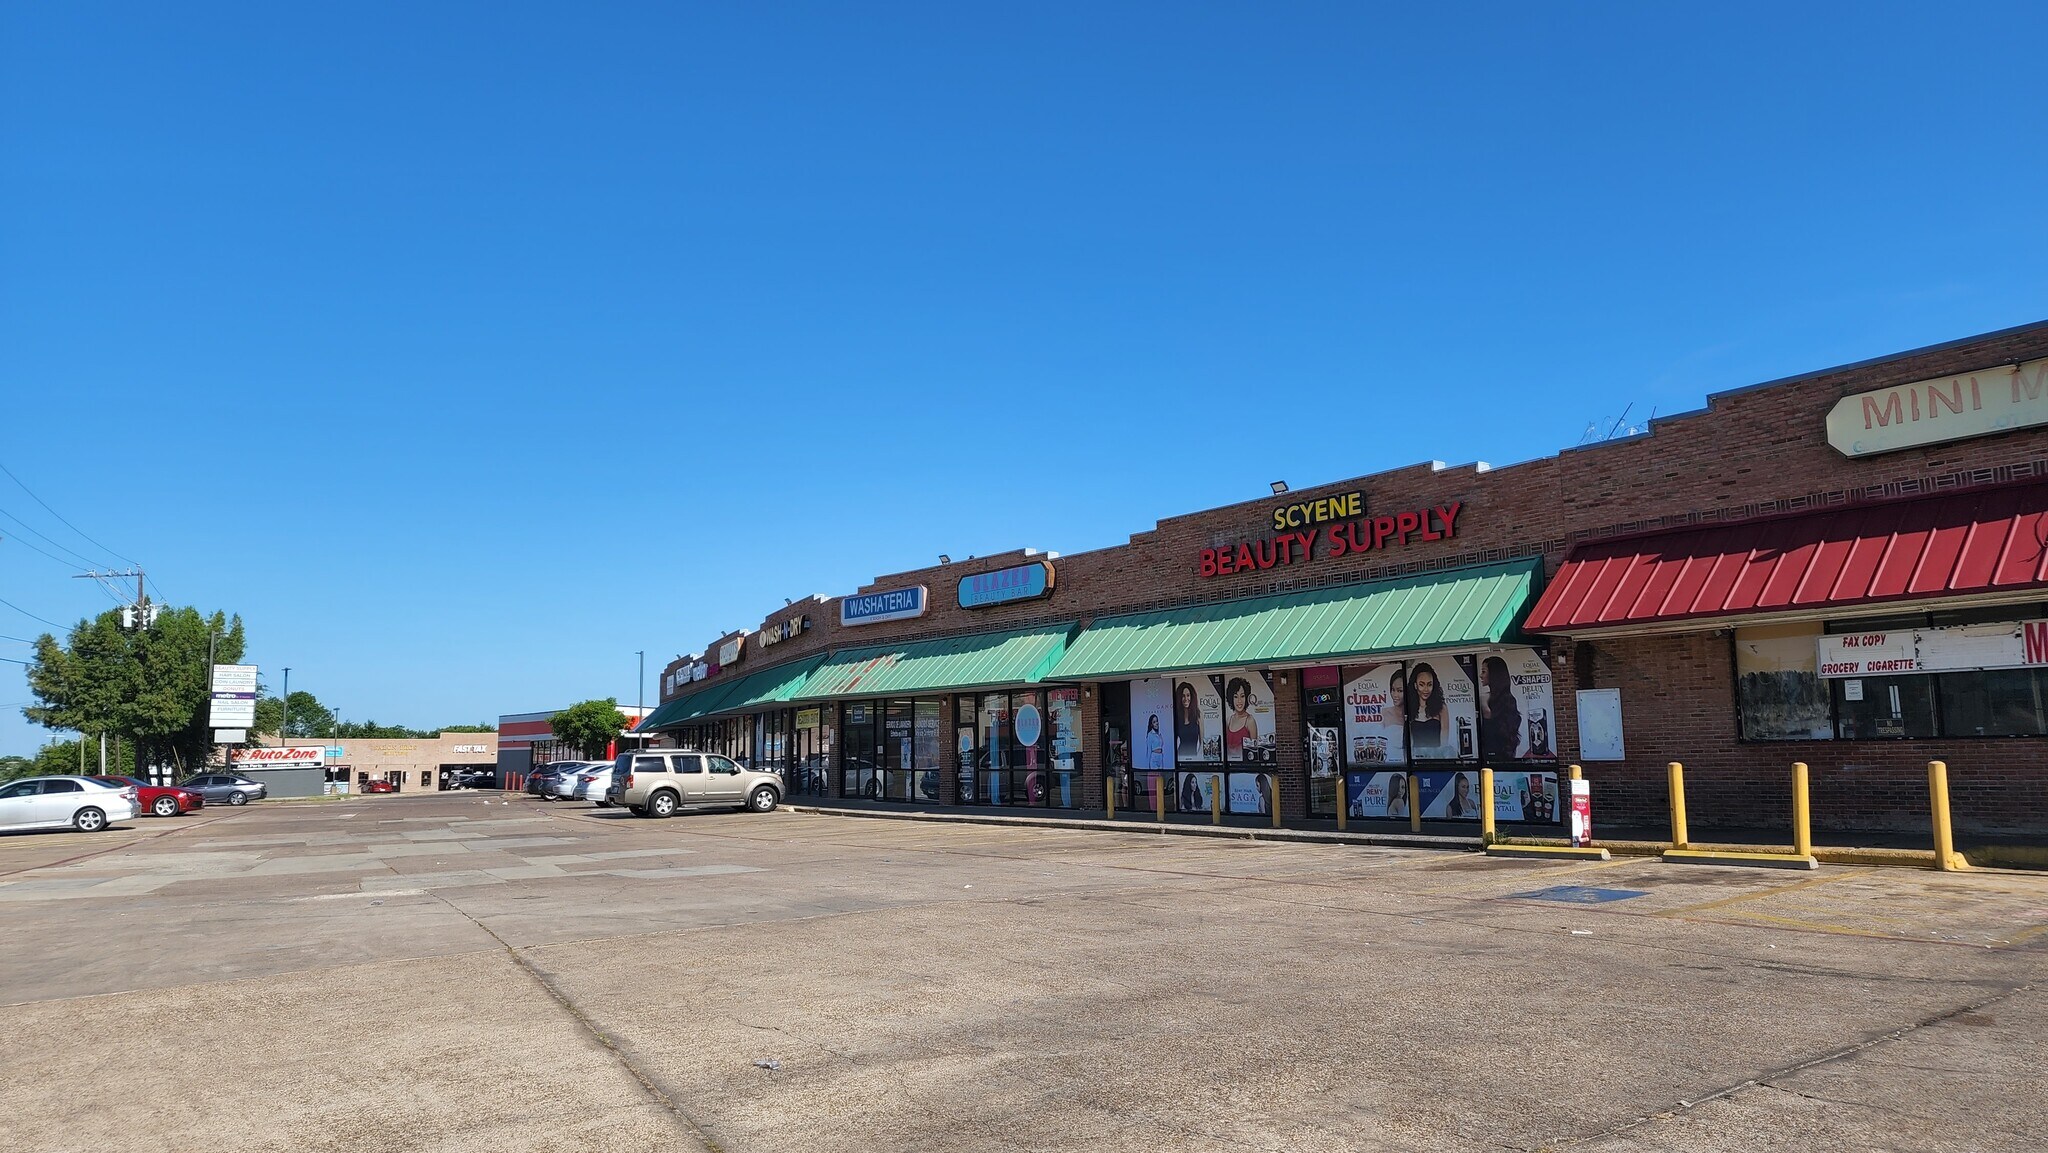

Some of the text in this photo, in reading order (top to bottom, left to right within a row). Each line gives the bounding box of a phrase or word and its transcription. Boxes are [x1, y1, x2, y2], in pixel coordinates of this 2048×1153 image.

[1861, 376, 1982, 430] MINI
[1273, 492, 1362, 530] SCYENE
[1200, 501, 1462, 577] BEAUTY SUPPLY
[972, 566, 1030, 593] GLAZED
[973, 586, 1029, 603] BEAUTY BAR
[849, 591, 913, 615] WASHATERIA
[1842, 634, 1887, 648] FAX COPY
[1821, 658, 1914, 674] GROCERY CIGARETTE
[1511, 674, 1550, 685] V-SHAPED
[1358, 682, 1378, 690] EQUAL
[1447, 683, 1471, 692] EQUAL
[1200, 697, 1220, 708] EQUAL
[1313, 694, 1331, 703] open
[1346, 693, 1387, 705] CUBAN
[1446, 696, 1474, 704] PONYTAIL
[1355, 705, 1382, 715] TWIST
[1355, 715, 1382, 723] BRAID
[453, 744, 488, 752] FAST TAX
[249, 749, 317, 760] AutoZone
[1474, 784, 1515, 796] EUAL
[1231, 792, 1257, 802] SAGA
[1364, 796, 1386, 806] PURE
